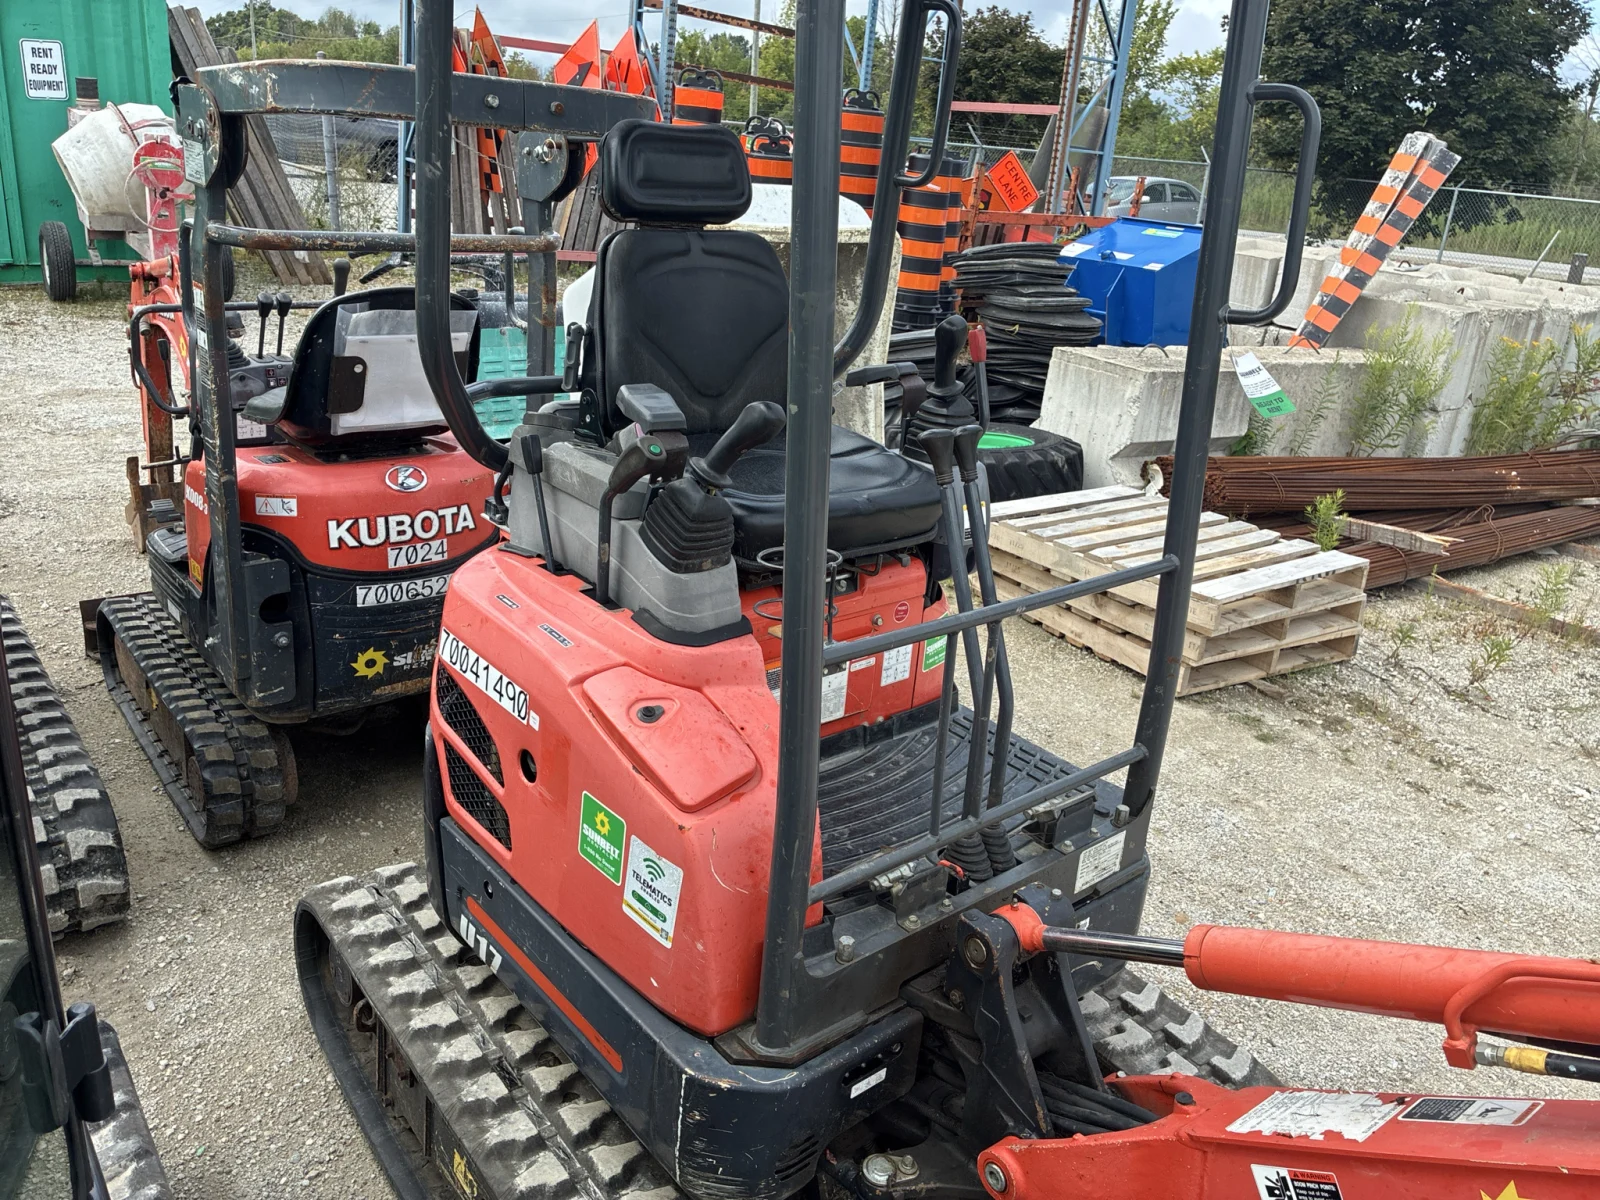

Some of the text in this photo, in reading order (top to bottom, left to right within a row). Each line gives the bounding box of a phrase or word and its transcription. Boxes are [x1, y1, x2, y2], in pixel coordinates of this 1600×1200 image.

[31, 47, 53, 59] RENT
[30, 63, 57, 75] READY
[29, 79, 63, 91] EQUIPMENT
[998, 174, 1018, 204] LANE
[1005, 160, 1032, 202] CENTRE
[1256, 396, 1284, 409] READY TO
[1266, 405, 1282, 414] RENT
[327, 503, 476, 549] KUBOTA
[390, 539, 447, 567] 7024
[358, 576, 450, 605] 700652
[441, 628, 528, 721] 70041490
[582, 823, 620, 860] SUNBELT
[632, 869, 672, 907] TELEMATICS
[460, 913, 502, 975] U17
[1300, 1171, 1331, 1181] WARNING
